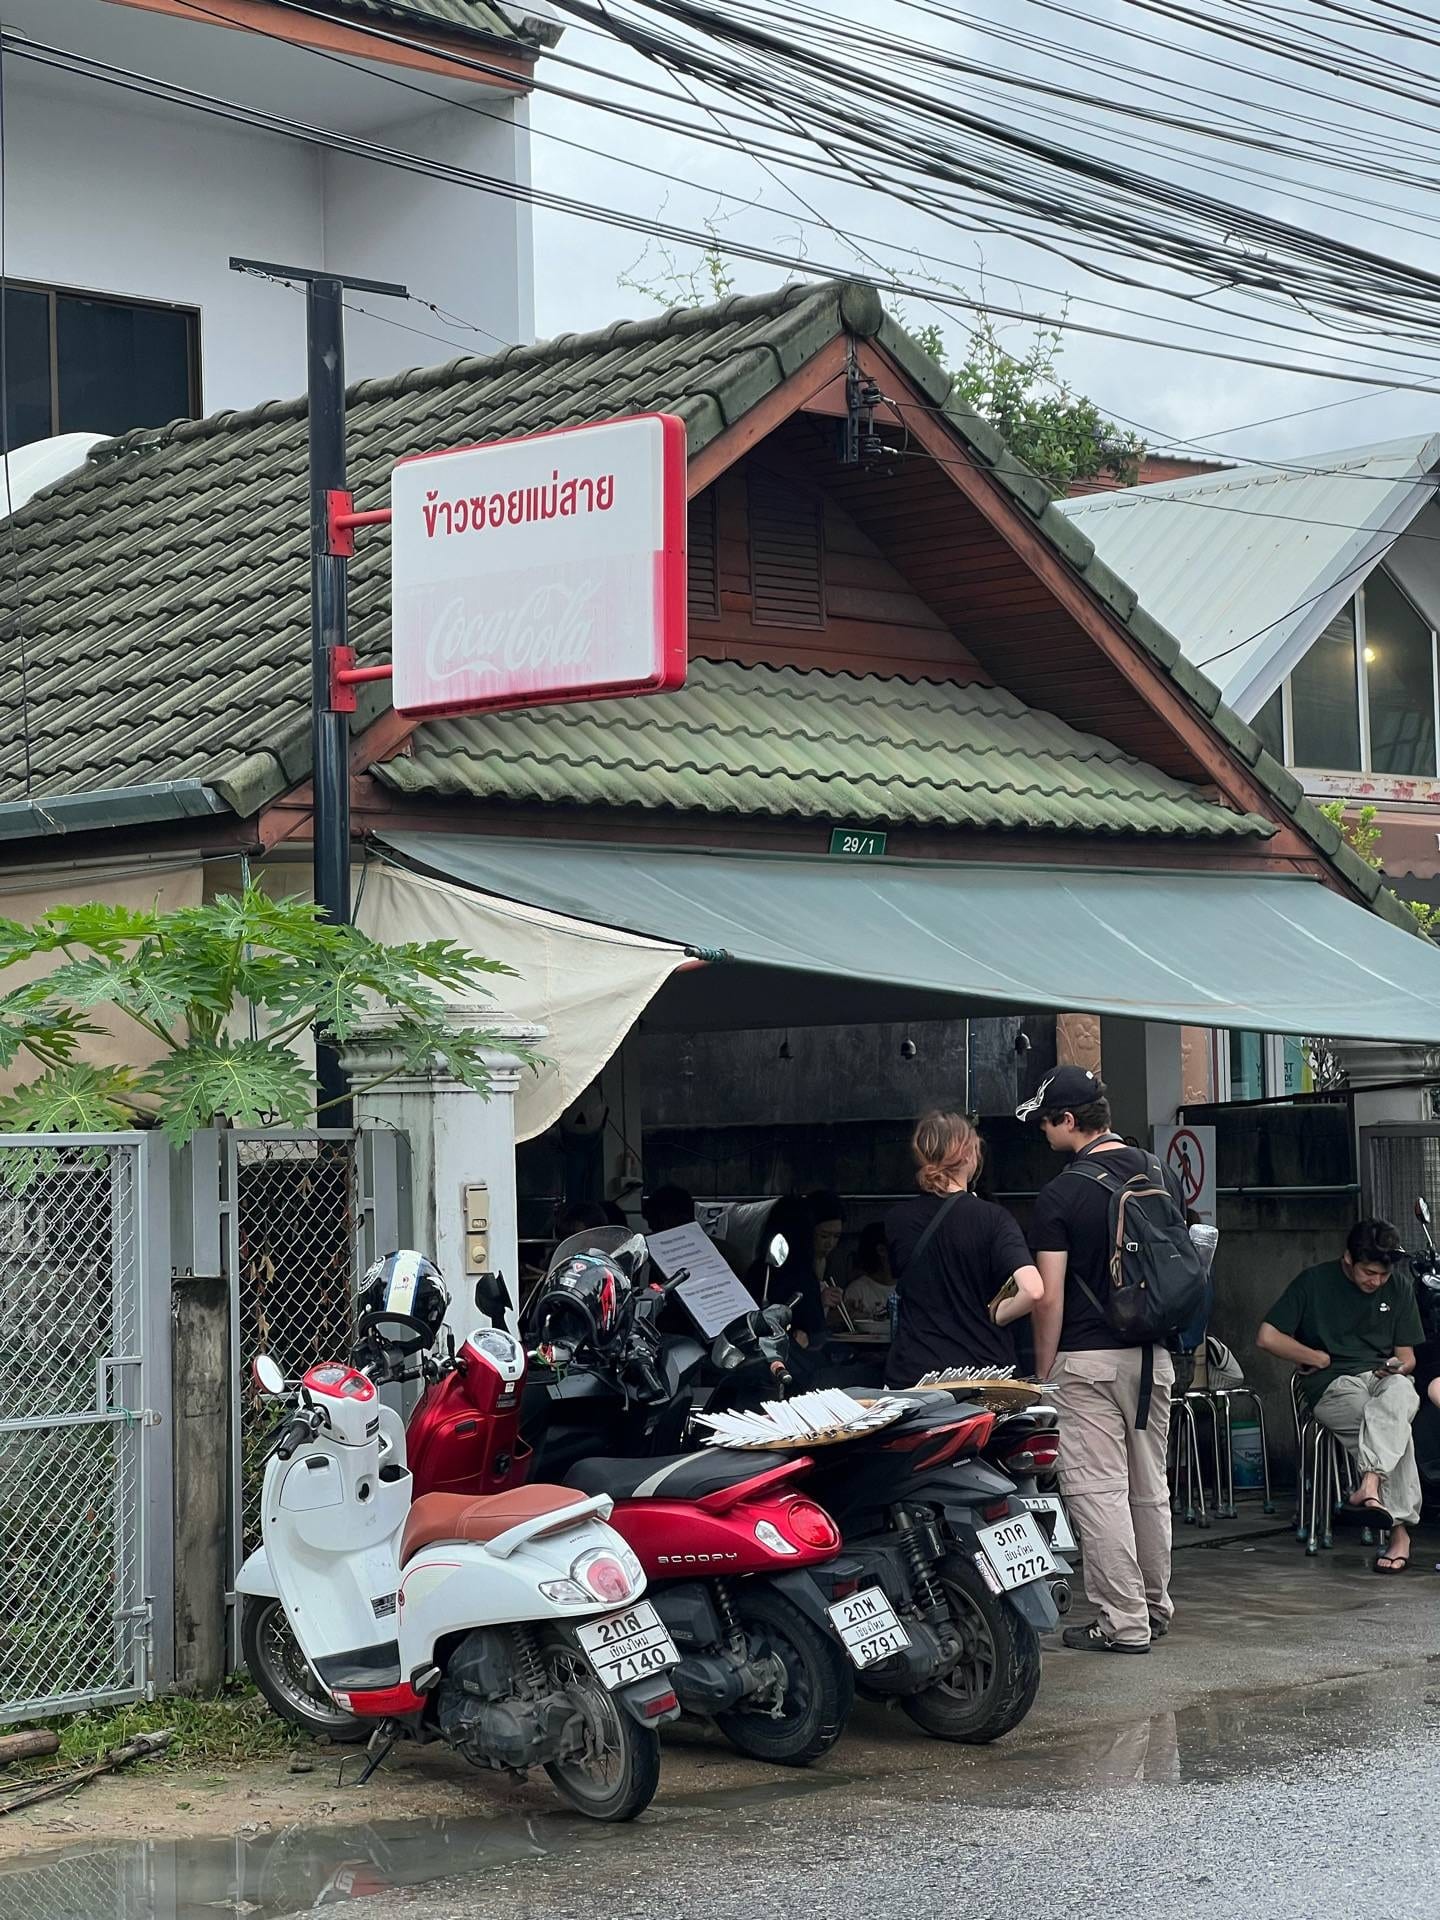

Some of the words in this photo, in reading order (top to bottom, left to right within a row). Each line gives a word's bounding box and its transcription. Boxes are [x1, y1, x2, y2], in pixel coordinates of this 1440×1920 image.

[422, 469, 615, 538] ข้าวซอยแม่สาย
[842, 836, 875, 854] 29/1
[1004, 1543, 1034, 1562] เชียงใหม่
[1006, 1555, 1049, 1583] 7272
[597, 1611, 642, 1643] 2กส
[855, 1616, 885, 1639] เชียงใหม่
[609, 1633, 650, 1658] เชียงใหม่
[860, 1632, 899, 1660] 6791
[609, 1648, 666, 1681] 7140
